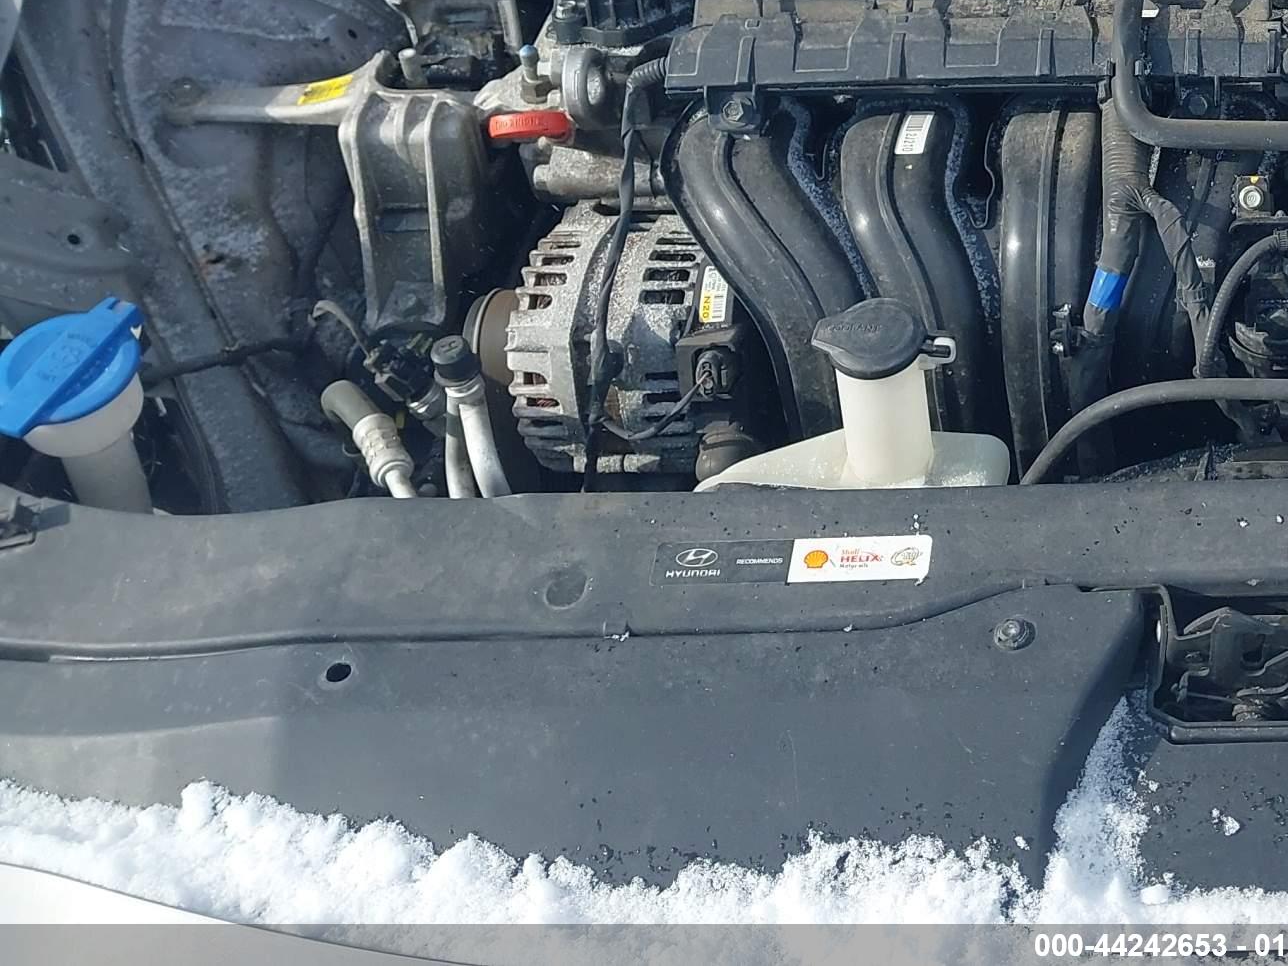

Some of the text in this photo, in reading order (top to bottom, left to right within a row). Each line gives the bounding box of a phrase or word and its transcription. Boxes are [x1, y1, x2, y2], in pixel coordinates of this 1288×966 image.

[702, 296, 711, 319] N20
[665, 557, 784, 579] HYUNDAI RECOMMENDS
[840, 554, 880, 563] HELIX
